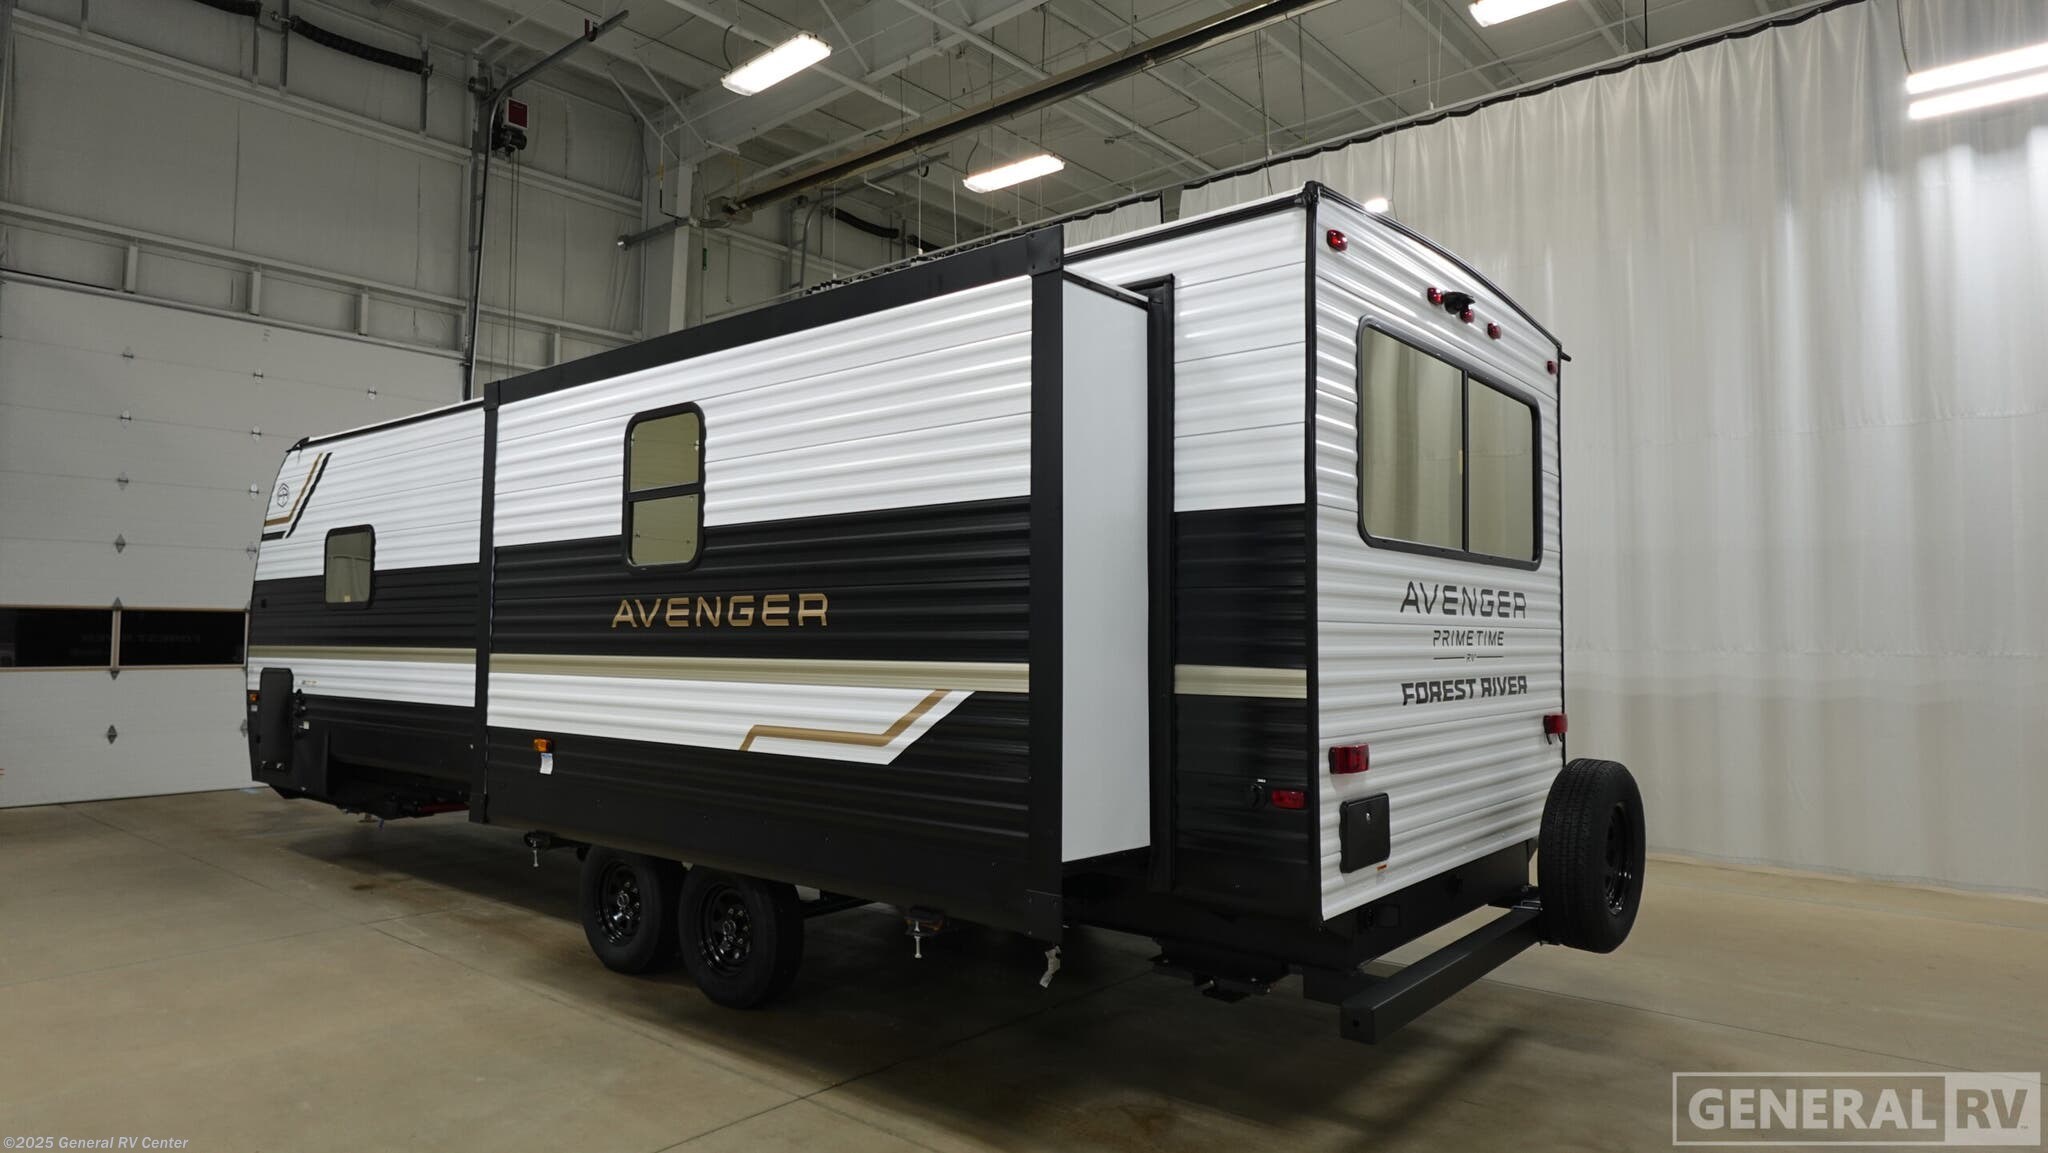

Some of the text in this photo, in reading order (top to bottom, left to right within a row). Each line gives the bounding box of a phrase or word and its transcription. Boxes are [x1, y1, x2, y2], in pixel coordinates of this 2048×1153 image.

[611, 593, 829, 628] AVENGER
[1400, 581, 1527, 619] AVENGER
[1401, 675, 1527, 706] FOREST RIVER
